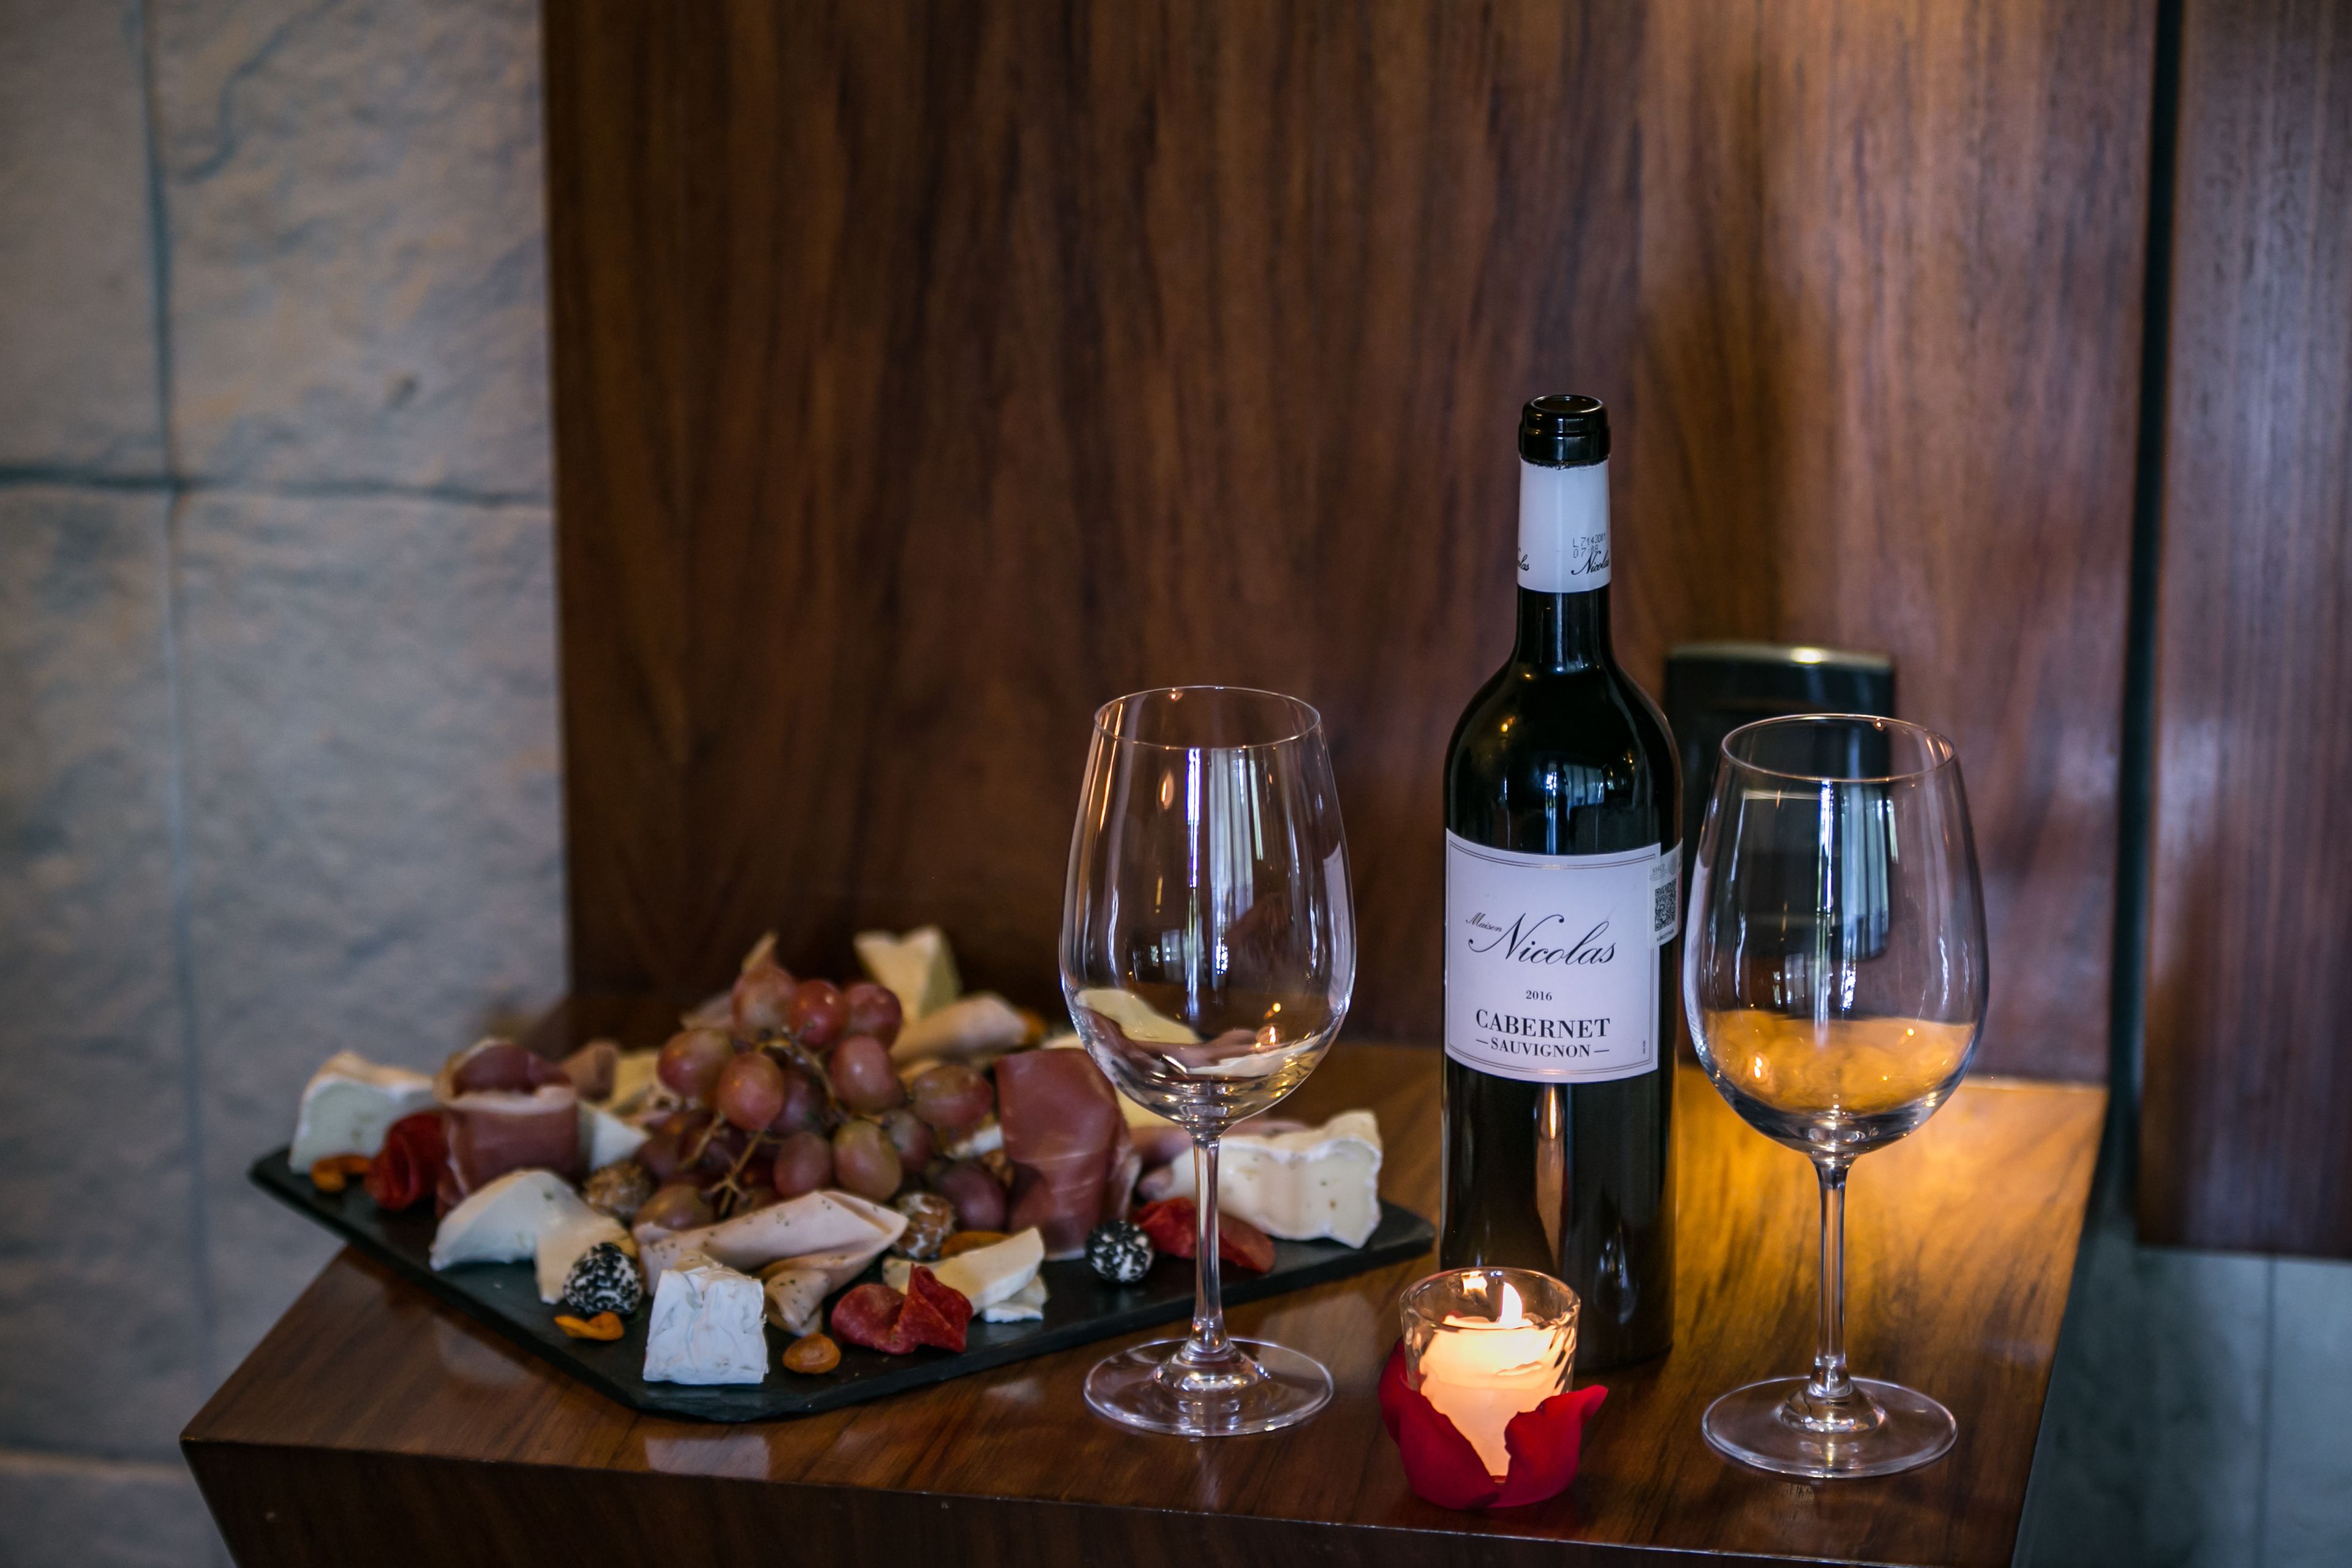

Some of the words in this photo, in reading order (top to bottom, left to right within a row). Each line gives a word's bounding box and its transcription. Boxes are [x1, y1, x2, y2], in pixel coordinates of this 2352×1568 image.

[1465, 912, 1502, 933] Maison
[1468, 913, 1616, 965] Nicolas
[1525, 990, 1553, 1001] 2016
[1476, 1009, 1611, 1038] CABERNET
[1491, 1038, 1591, 1057] SAUVIGNON
